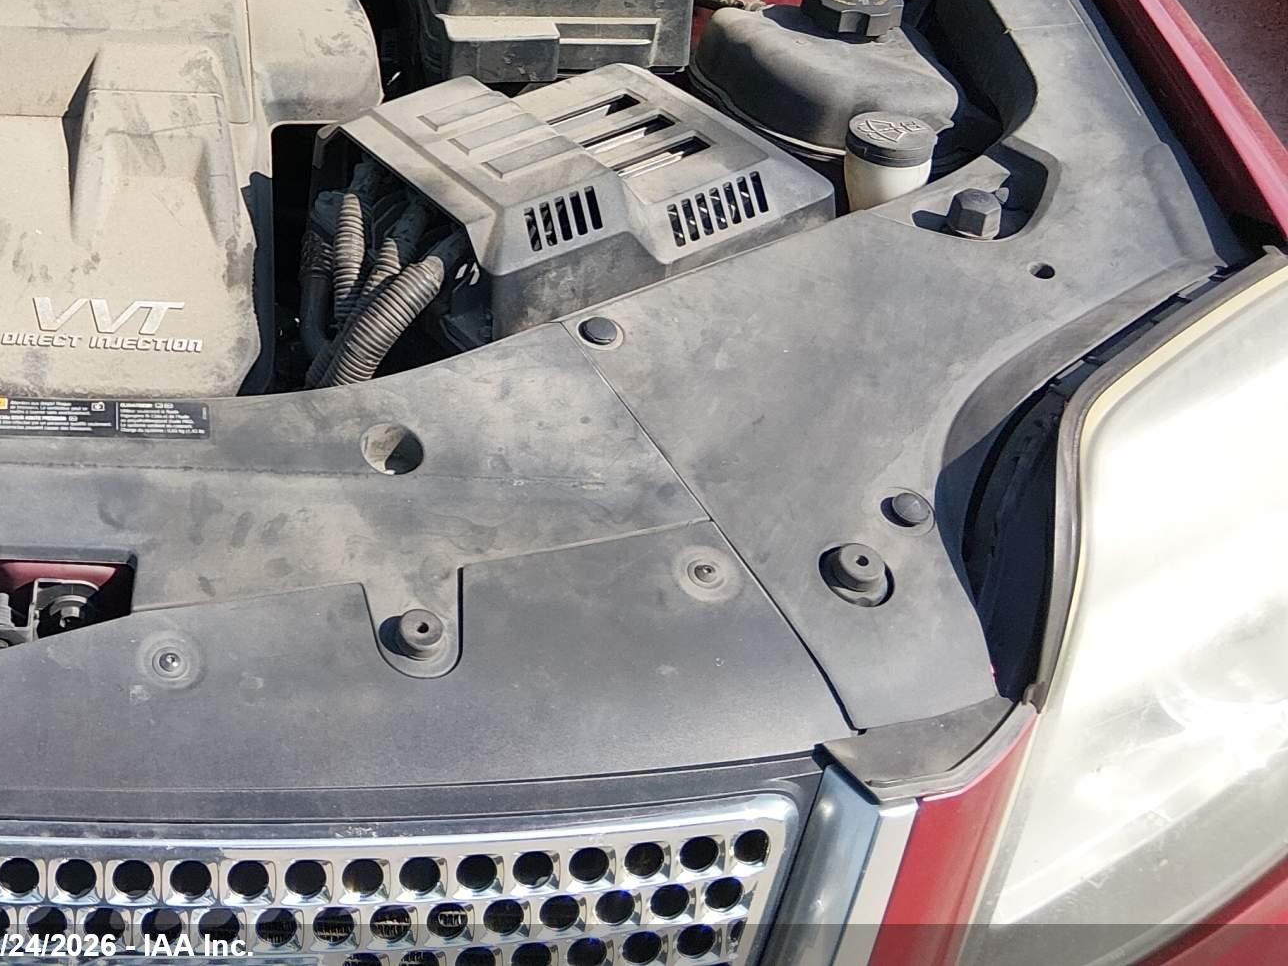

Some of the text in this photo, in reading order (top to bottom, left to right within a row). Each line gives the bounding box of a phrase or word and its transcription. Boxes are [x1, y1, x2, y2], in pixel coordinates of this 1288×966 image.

[32, 296, 186, 335] VVT
[1, 333, 204, 353] DIRECT INJECTION
